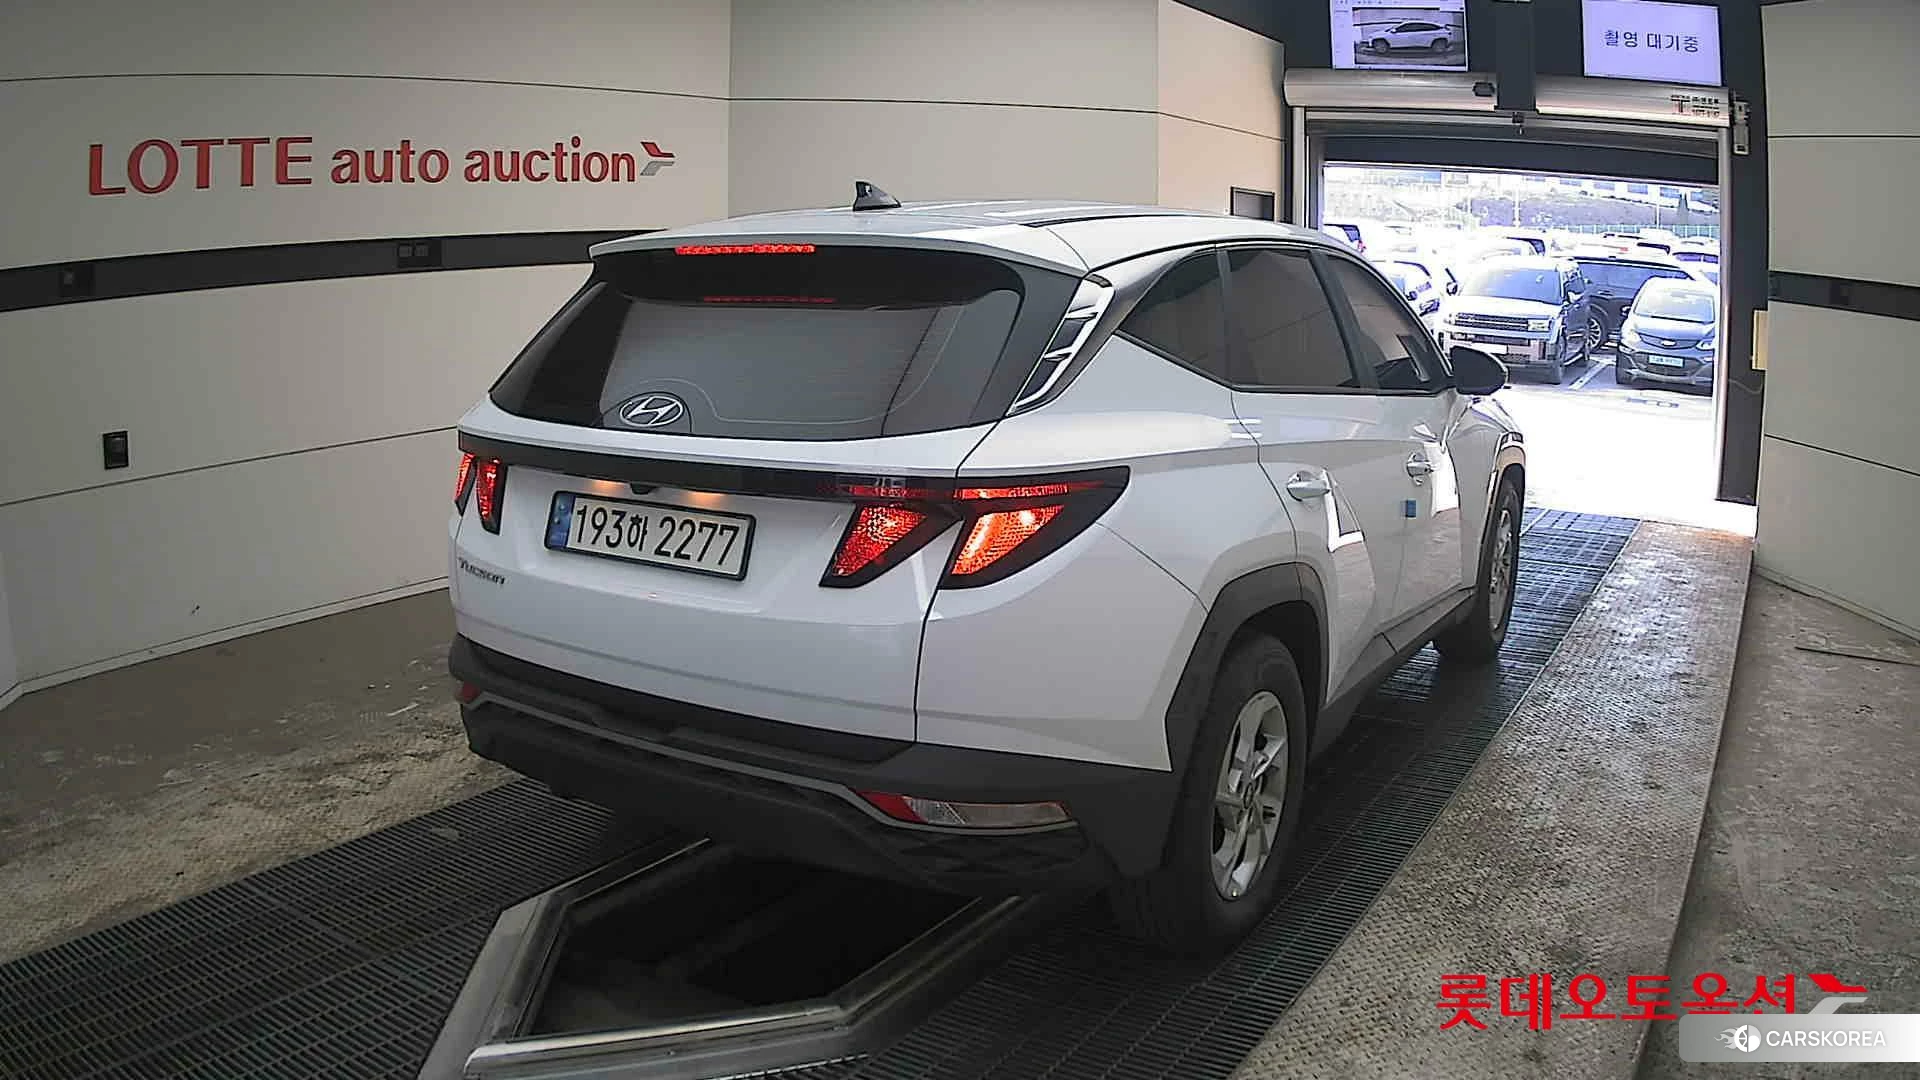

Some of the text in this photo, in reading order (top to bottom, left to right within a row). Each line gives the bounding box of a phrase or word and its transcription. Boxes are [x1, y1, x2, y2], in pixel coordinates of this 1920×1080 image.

[1604, 30, 1698, 53] 촬영 대기중
[88, 135, 636, 196] LOTTE auto auction
[576, 504, 740, 566] 193하 2277
